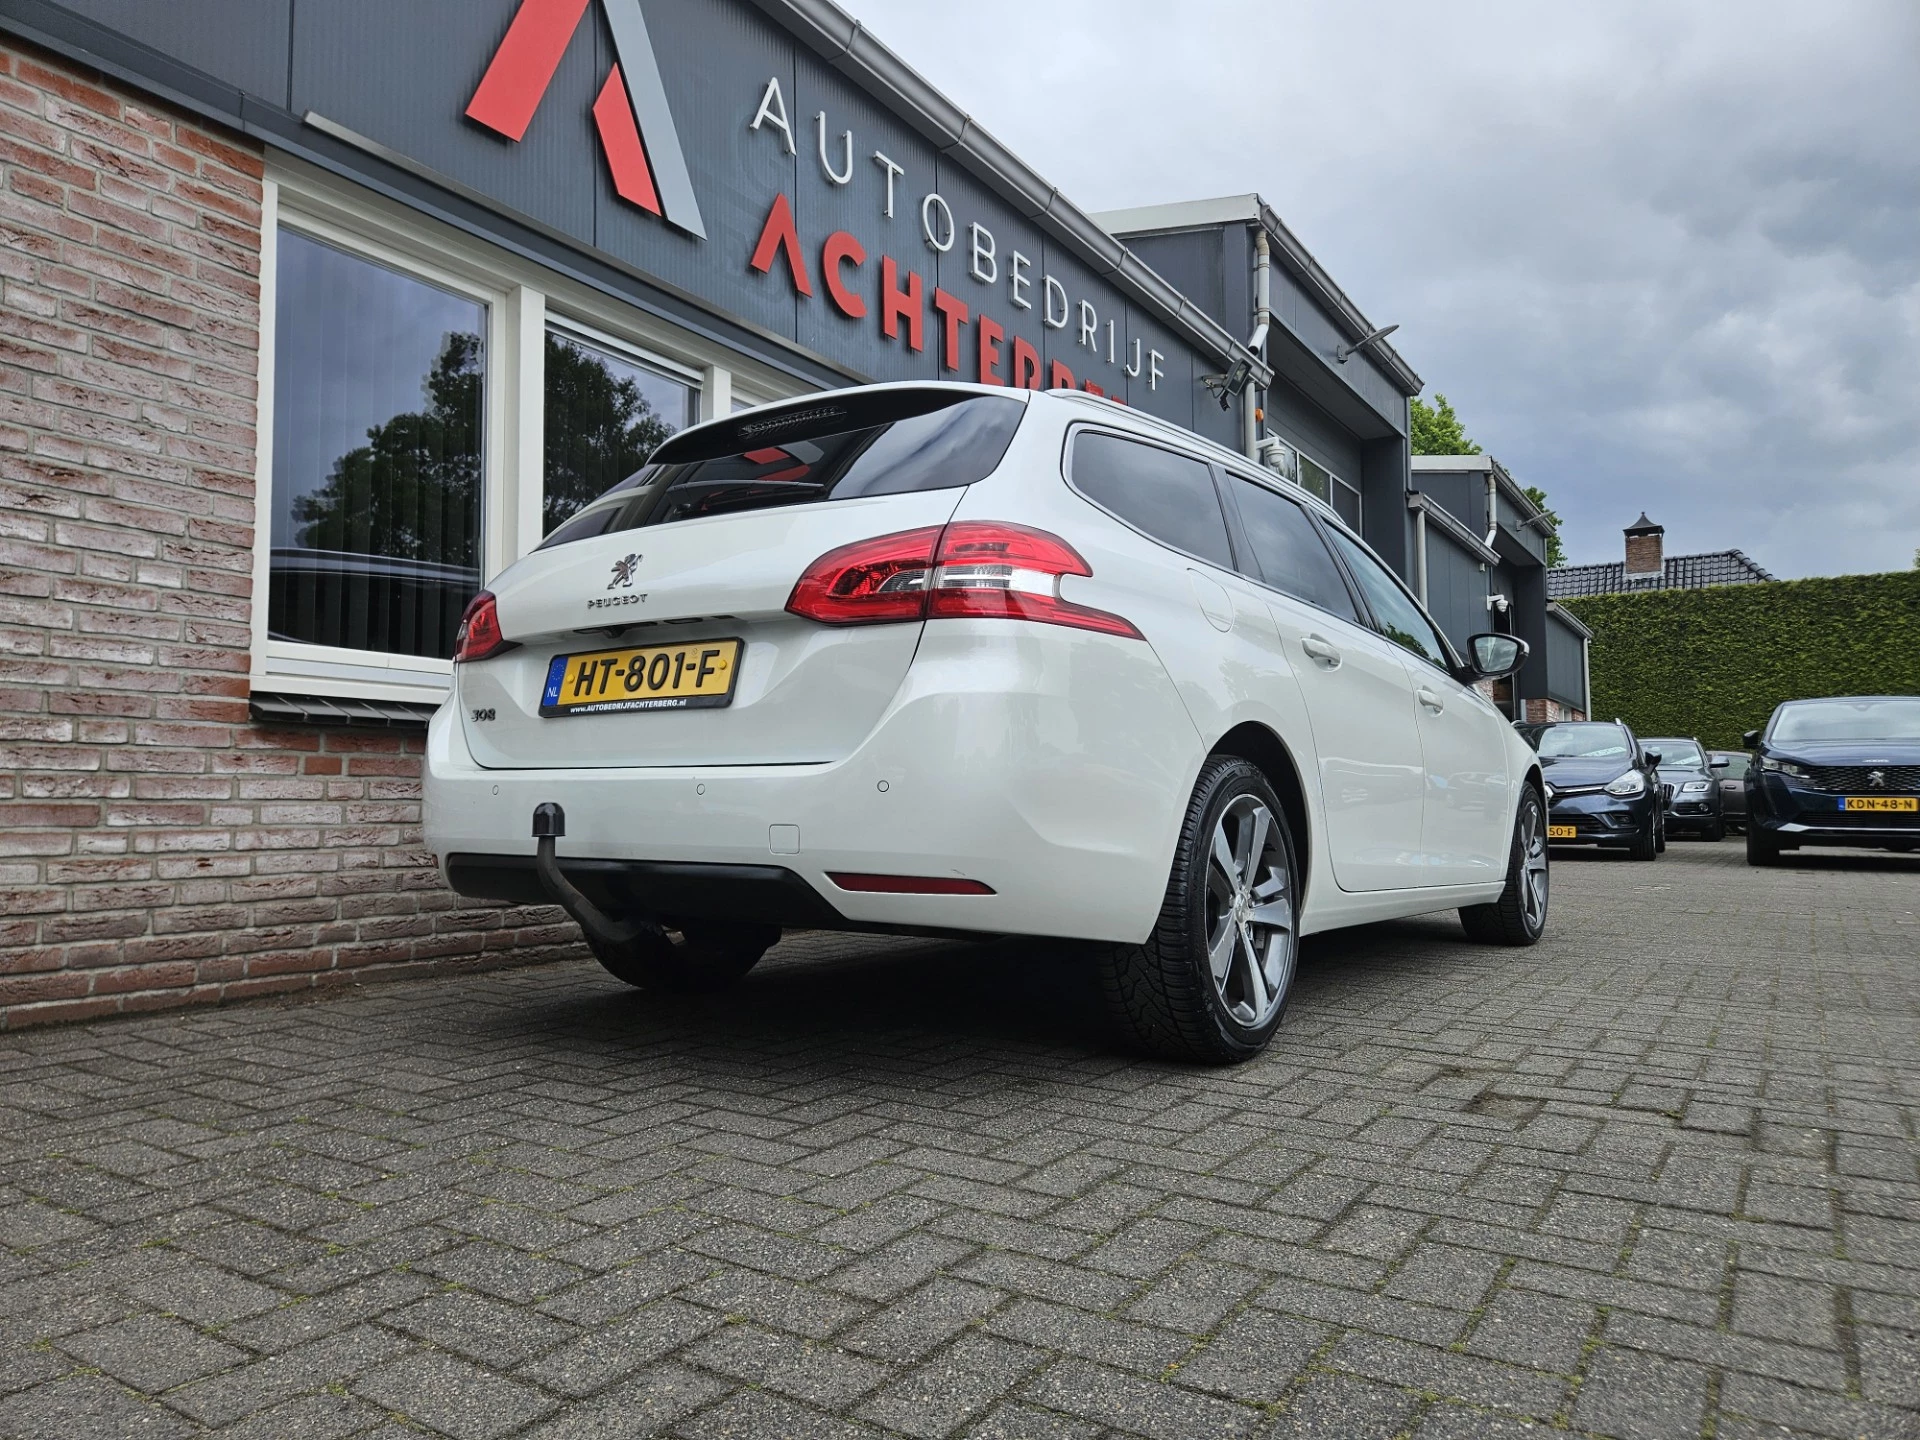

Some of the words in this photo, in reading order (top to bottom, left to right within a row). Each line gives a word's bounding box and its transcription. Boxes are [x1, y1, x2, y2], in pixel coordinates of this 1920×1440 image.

[750, 77, 1165, 391] AUTOBEDRIJF
[750, 192, 1127, 407] ACHTER
[587, 593, 648, 610] PEUGEOT
[573, 649, 720, 697] HT-801-F
[547, 686, 558, 698] NL
[570, 698, 687, 713] www.AUTOBEDRIJFACHTERBERG.nl
[471, 708, 497, 722] 308
[1847, 799, 1913, 810] KDN-48-N
